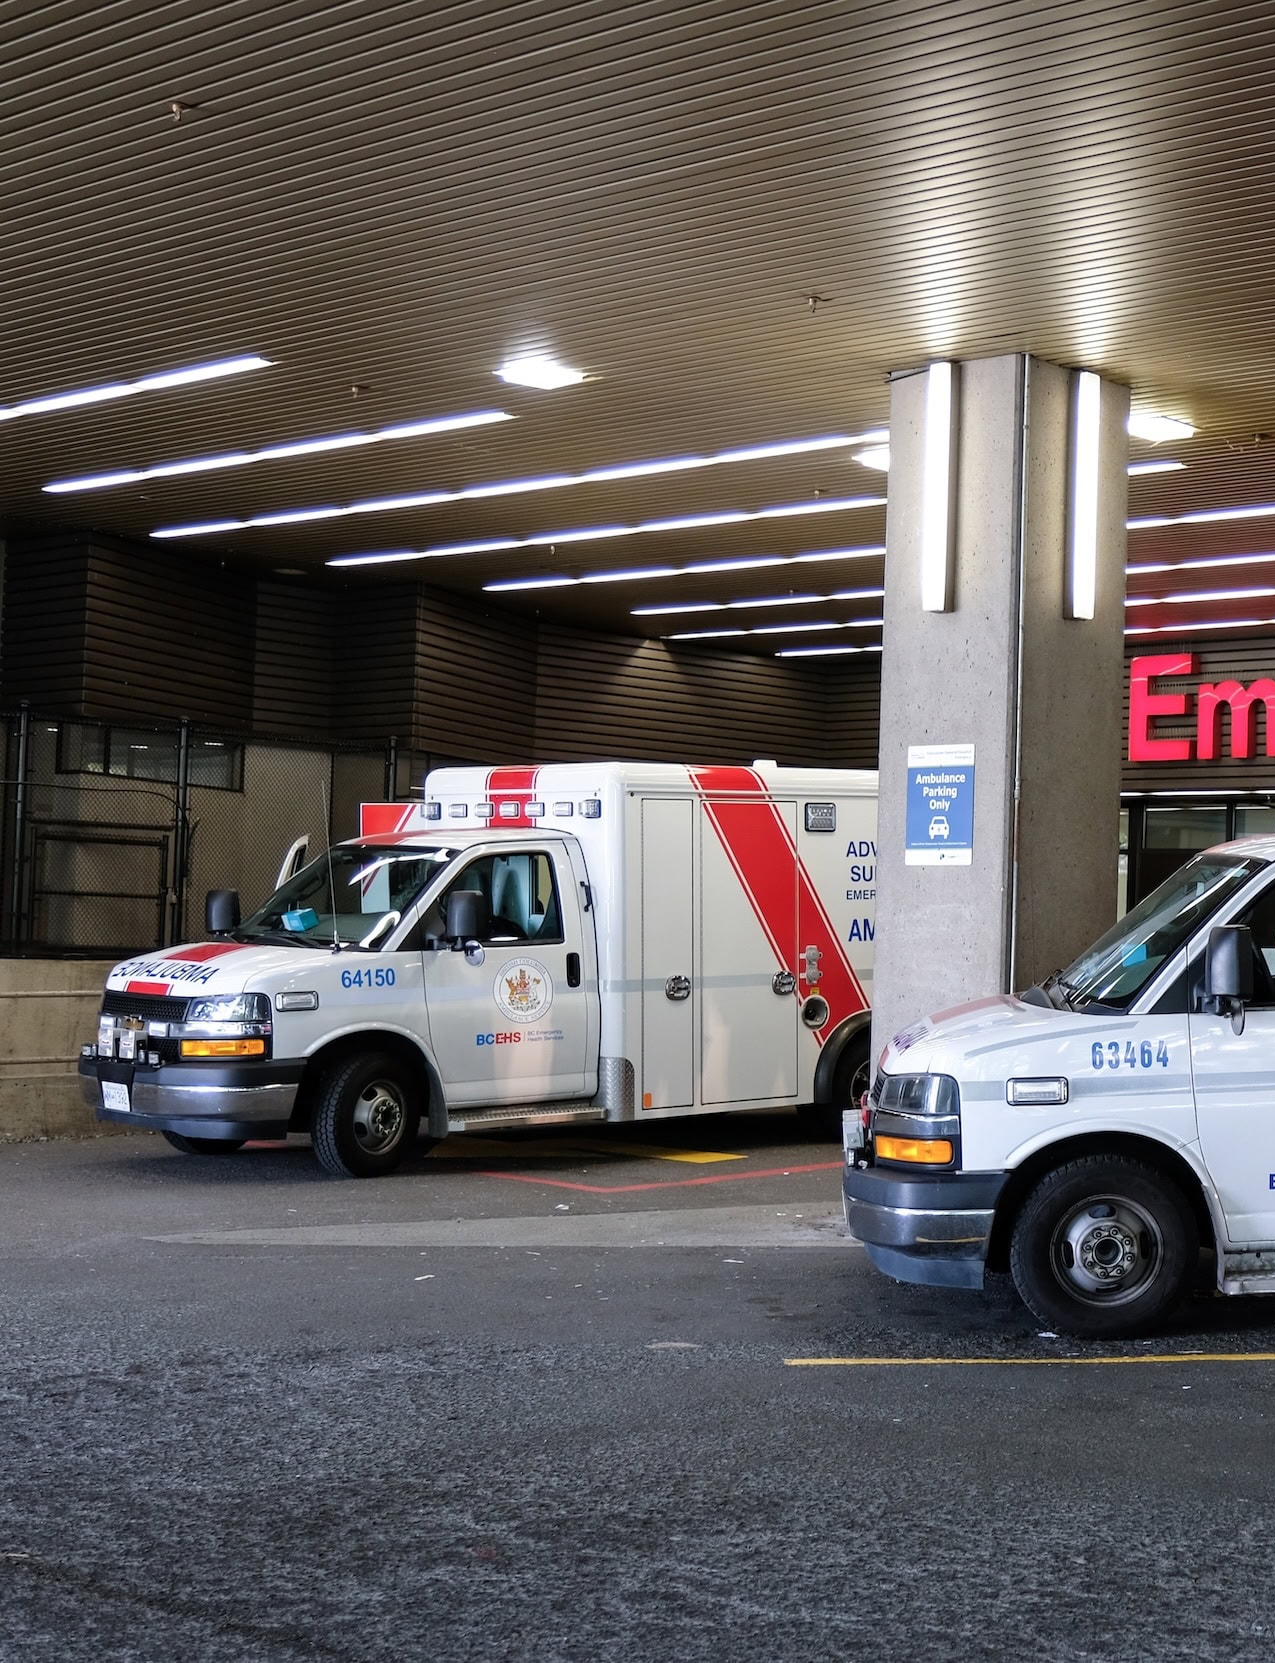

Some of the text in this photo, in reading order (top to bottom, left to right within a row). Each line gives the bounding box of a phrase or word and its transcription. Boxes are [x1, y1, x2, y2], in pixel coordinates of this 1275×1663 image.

[916, 772, 966, 784] Ambulance
[923, 786, 957, 798] Parking
[929, 799, 950, 812] Only
[341, 967, 396, 990] 64150
[476, 1032, 522, 1046] BCEHS
[1091, 1040, 1169, 1070] 63464
